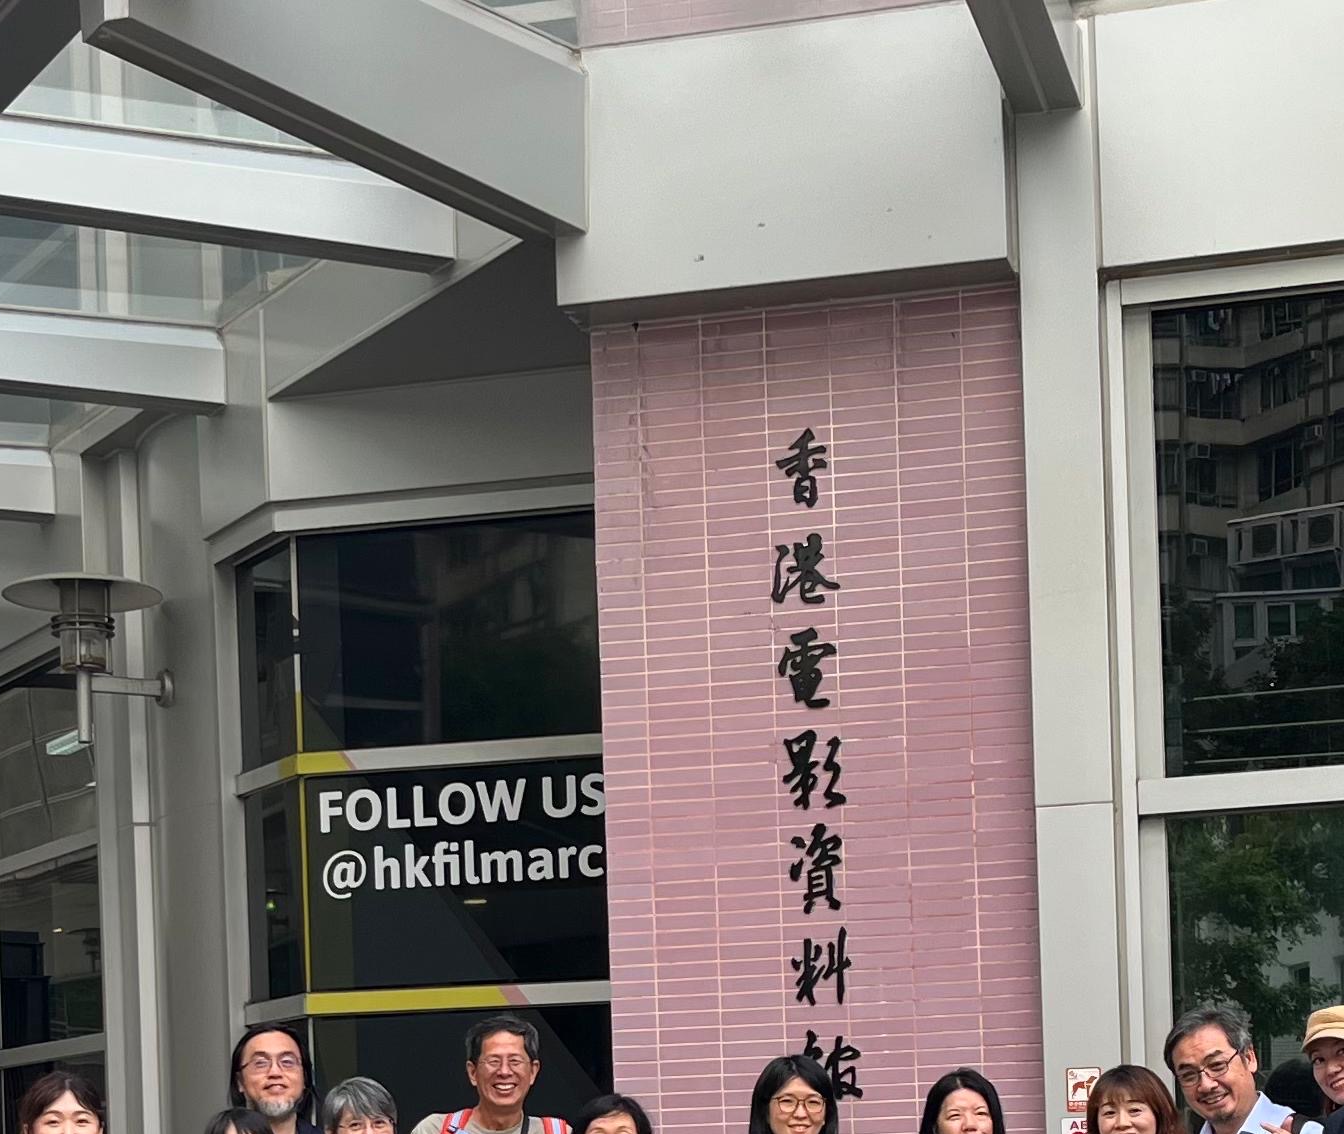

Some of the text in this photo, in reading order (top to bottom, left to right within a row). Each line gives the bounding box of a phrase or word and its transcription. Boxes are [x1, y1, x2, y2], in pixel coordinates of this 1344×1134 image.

[319, 773, 605, 834] FOLLOW US
[322, 840, 605, 900] @hkfilmarc
[1070, 1120, 1088, 1130] AE
